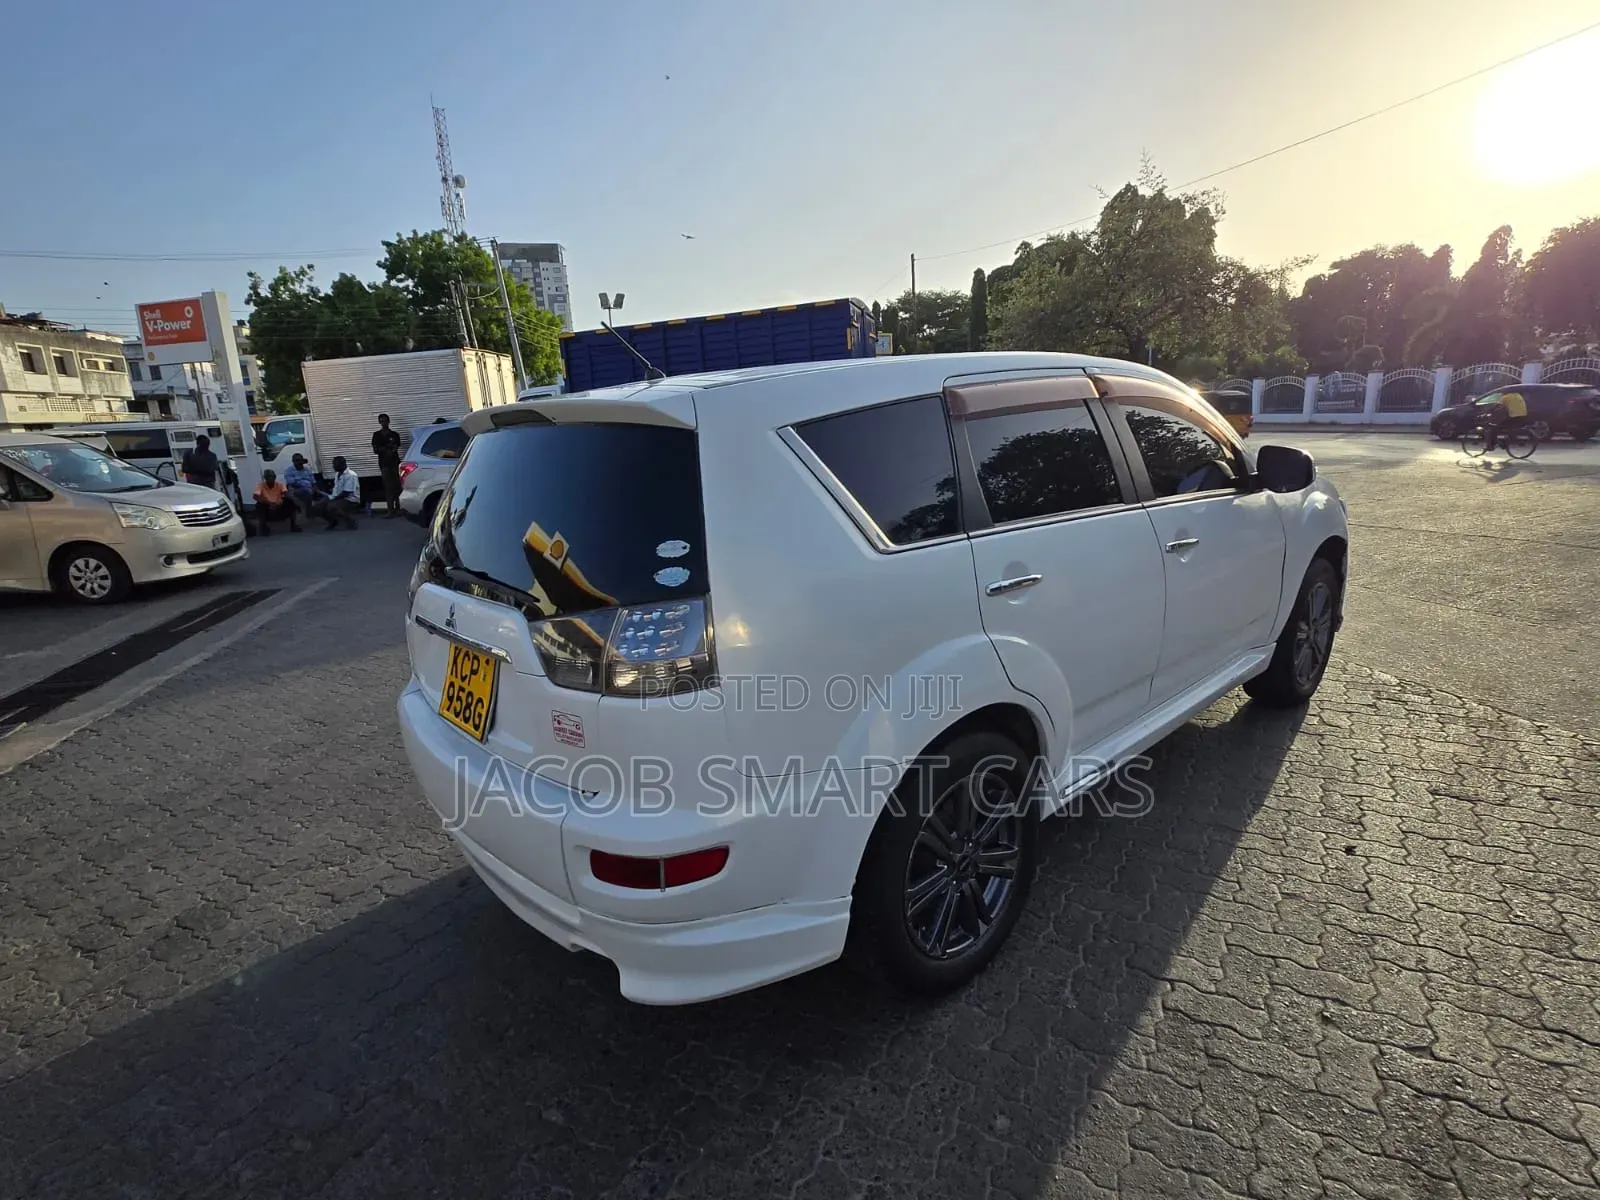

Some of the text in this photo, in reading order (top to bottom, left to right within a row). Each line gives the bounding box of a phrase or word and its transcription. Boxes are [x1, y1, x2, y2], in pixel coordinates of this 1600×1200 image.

[143, 309, 161, 320] Shell
[145, 320, 192, 332] V-Power
[450, 645, 480, 686] KCP
[446, 683, 484, 732] 958G
